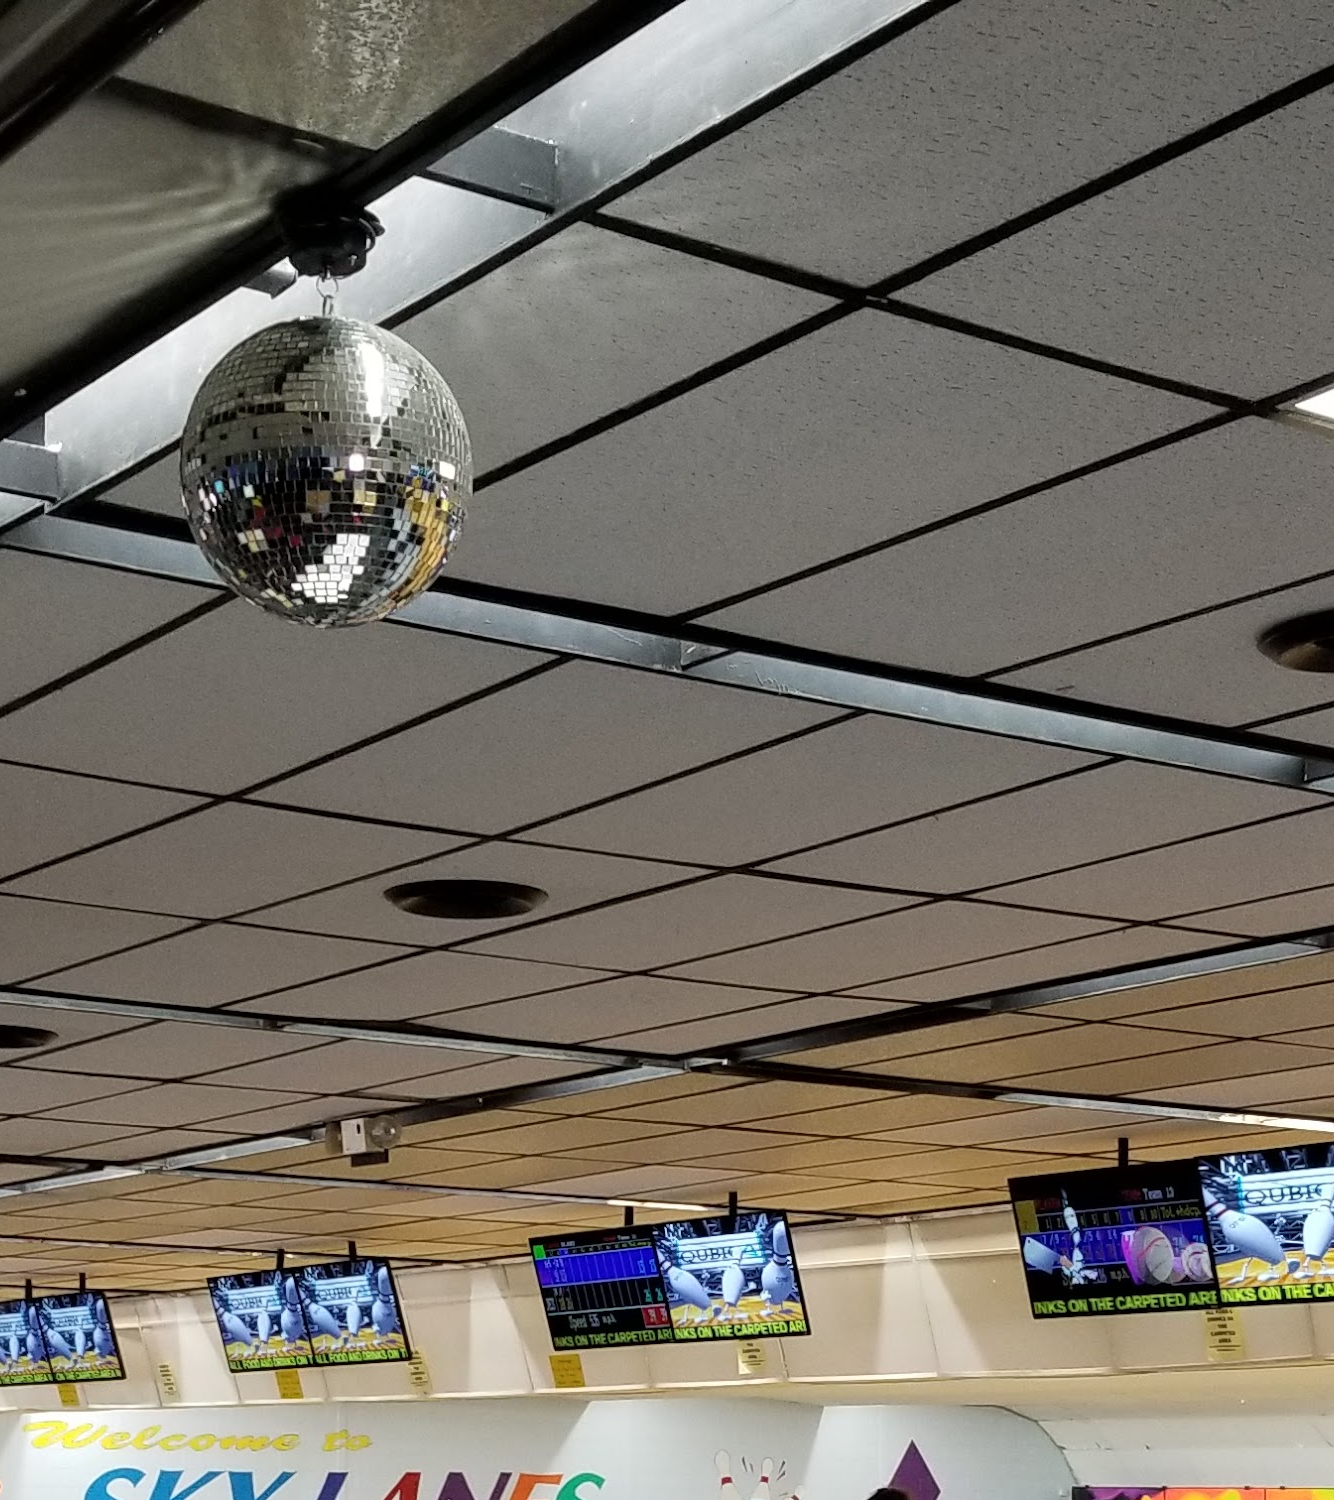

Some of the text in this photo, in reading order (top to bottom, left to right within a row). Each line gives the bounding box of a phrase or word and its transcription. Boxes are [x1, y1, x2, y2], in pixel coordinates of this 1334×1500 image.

[1258, 1286, 1281, 1301] ON
[1282, 1284, 1313, 1299] THE
[1068, 1299, 1088, 1312] ON
[1088, 1297, 1114, 1311] THE
[1115, 1293, 1186, 1309] CARPETED
[574, 1335, 589, 1346] ON
[588, 1333, 607, 1345] THE
[607, 1330, 656, 1343] CARPETED
[697, 1327, 713, 1338] ON
[713, 1325, 734, 1337] THE
[733, 1322, 788, 1335] CARPETED
[23, 1421, 372, 1451] Welcome to
